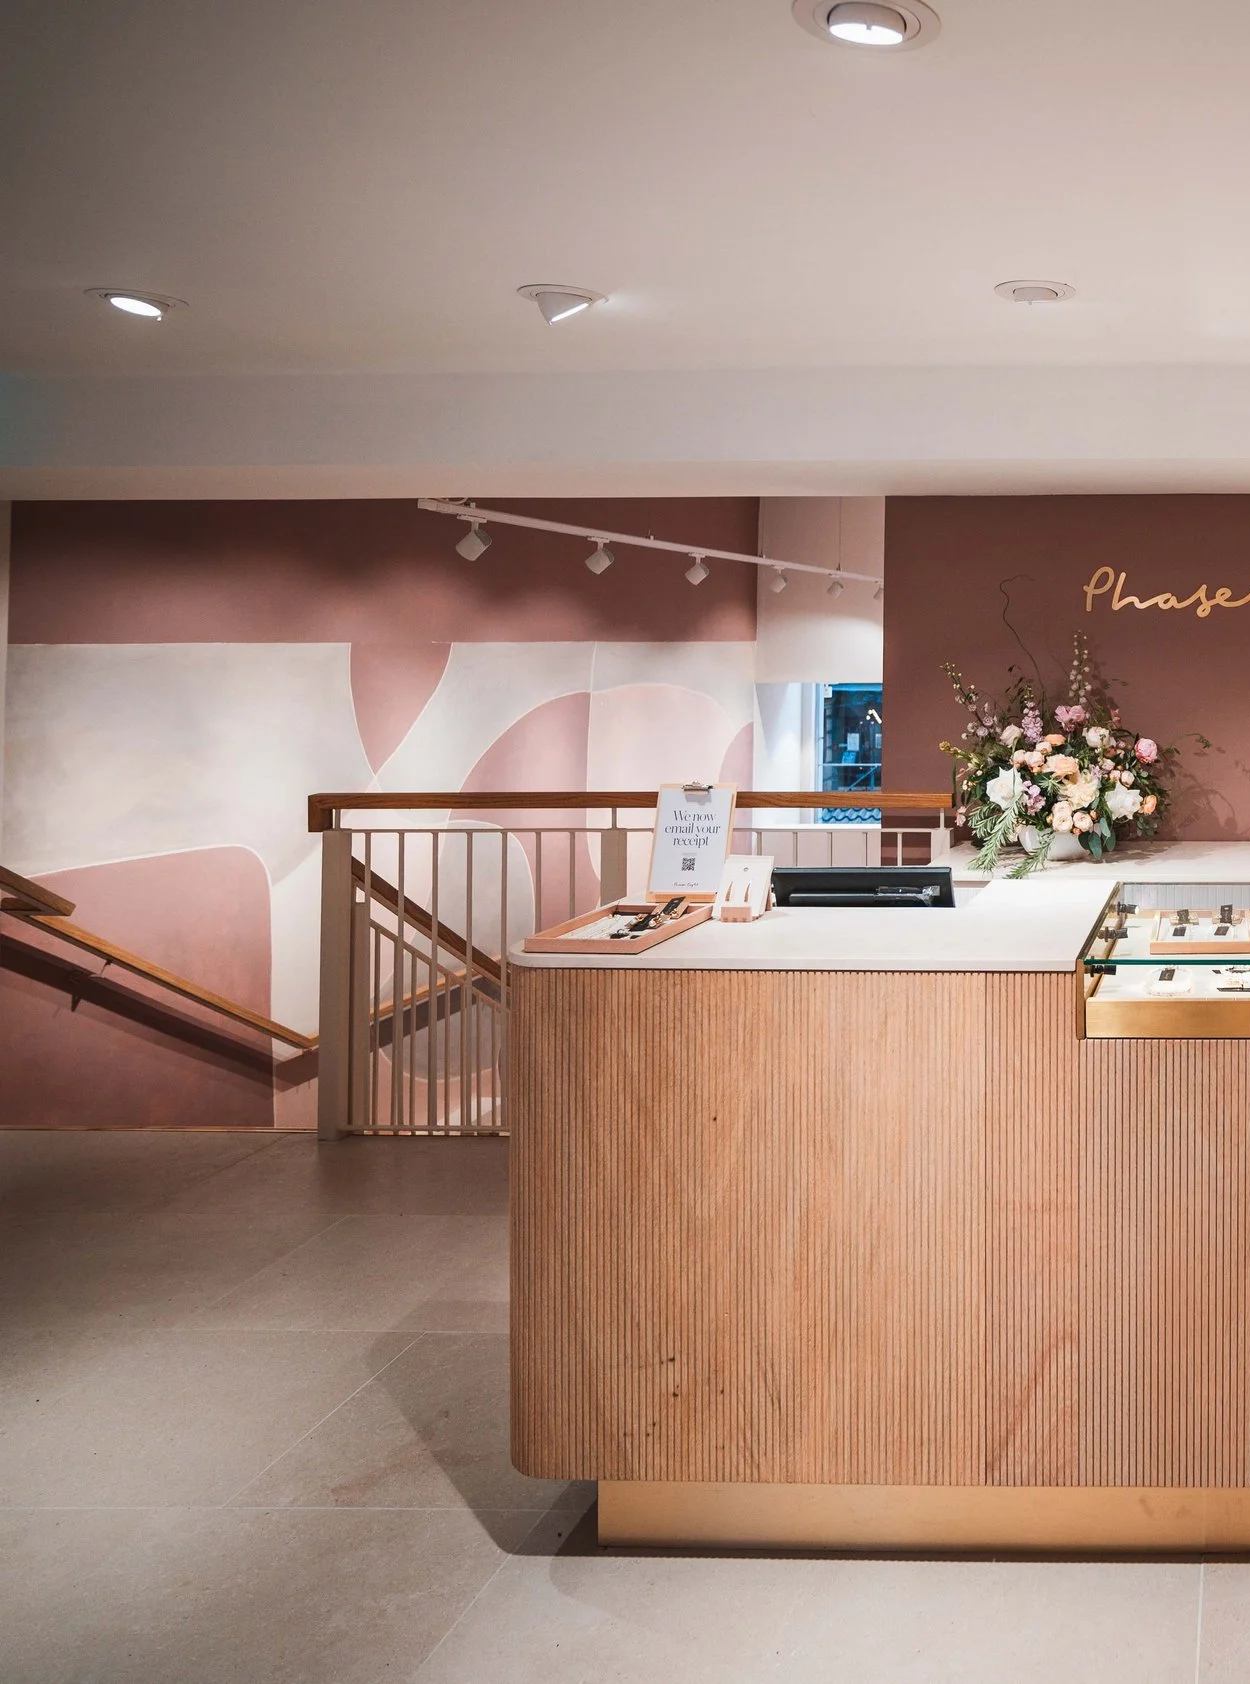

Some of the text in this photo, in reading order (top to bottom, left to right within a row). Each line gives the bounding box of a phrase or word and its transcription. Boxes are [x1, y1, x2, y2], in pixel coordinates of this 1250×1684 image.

[673, 810, 715, 822] We now
[664, 822, 721, 838] email your
[673, 836, 709, 849] receipt
